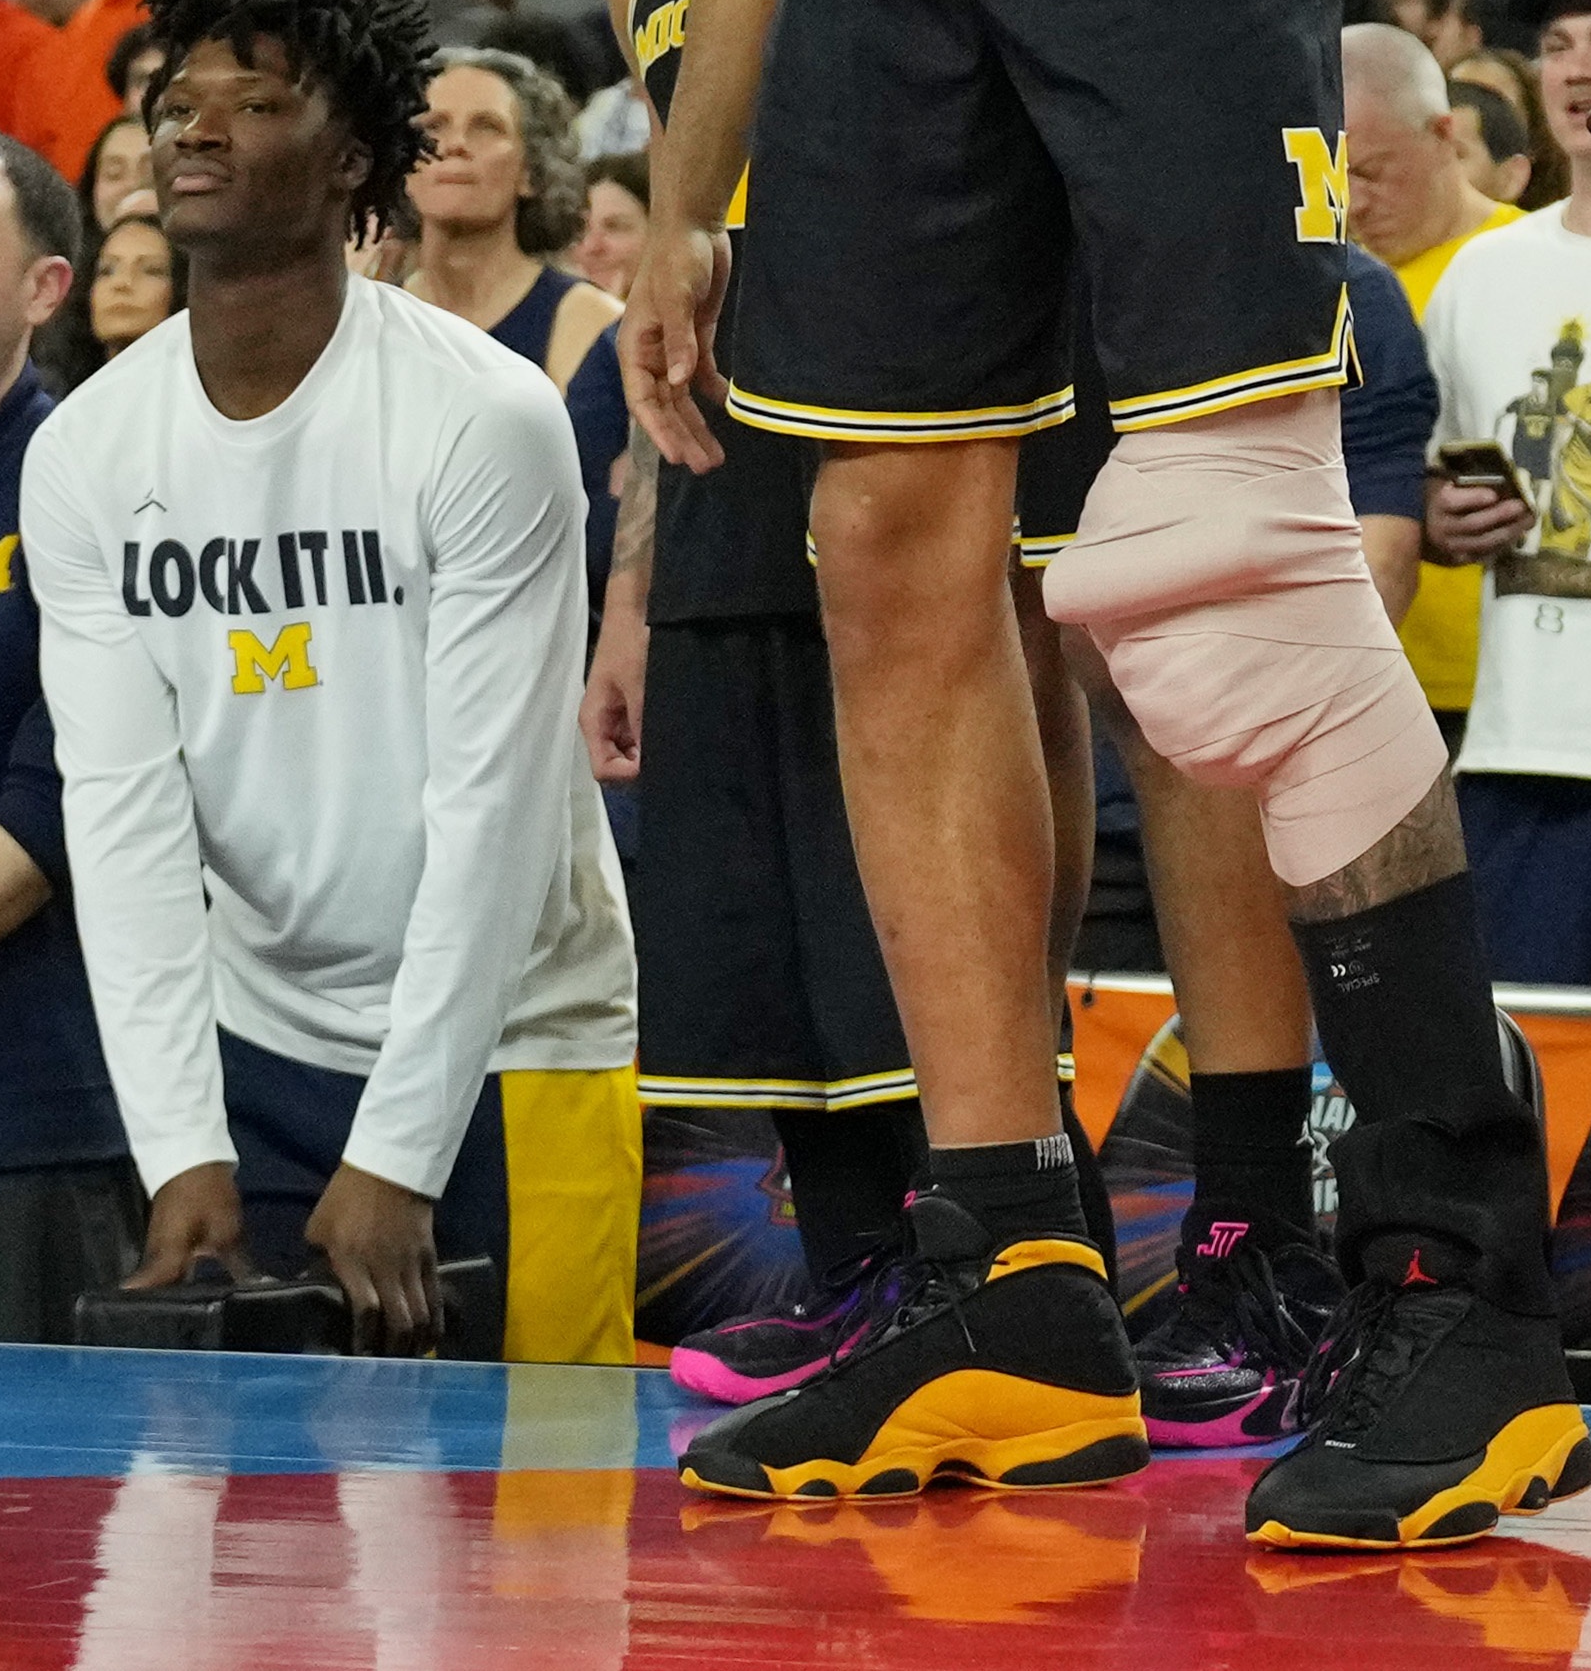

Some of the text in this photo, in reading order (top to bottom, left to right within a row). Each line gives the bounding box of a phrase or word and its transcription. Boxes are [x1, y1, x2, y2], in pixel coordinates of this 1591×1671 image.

[122, 536, 271, 618] LOCK
[278, 532, 329, 609] IT
[227, 621, 319, 695] M
